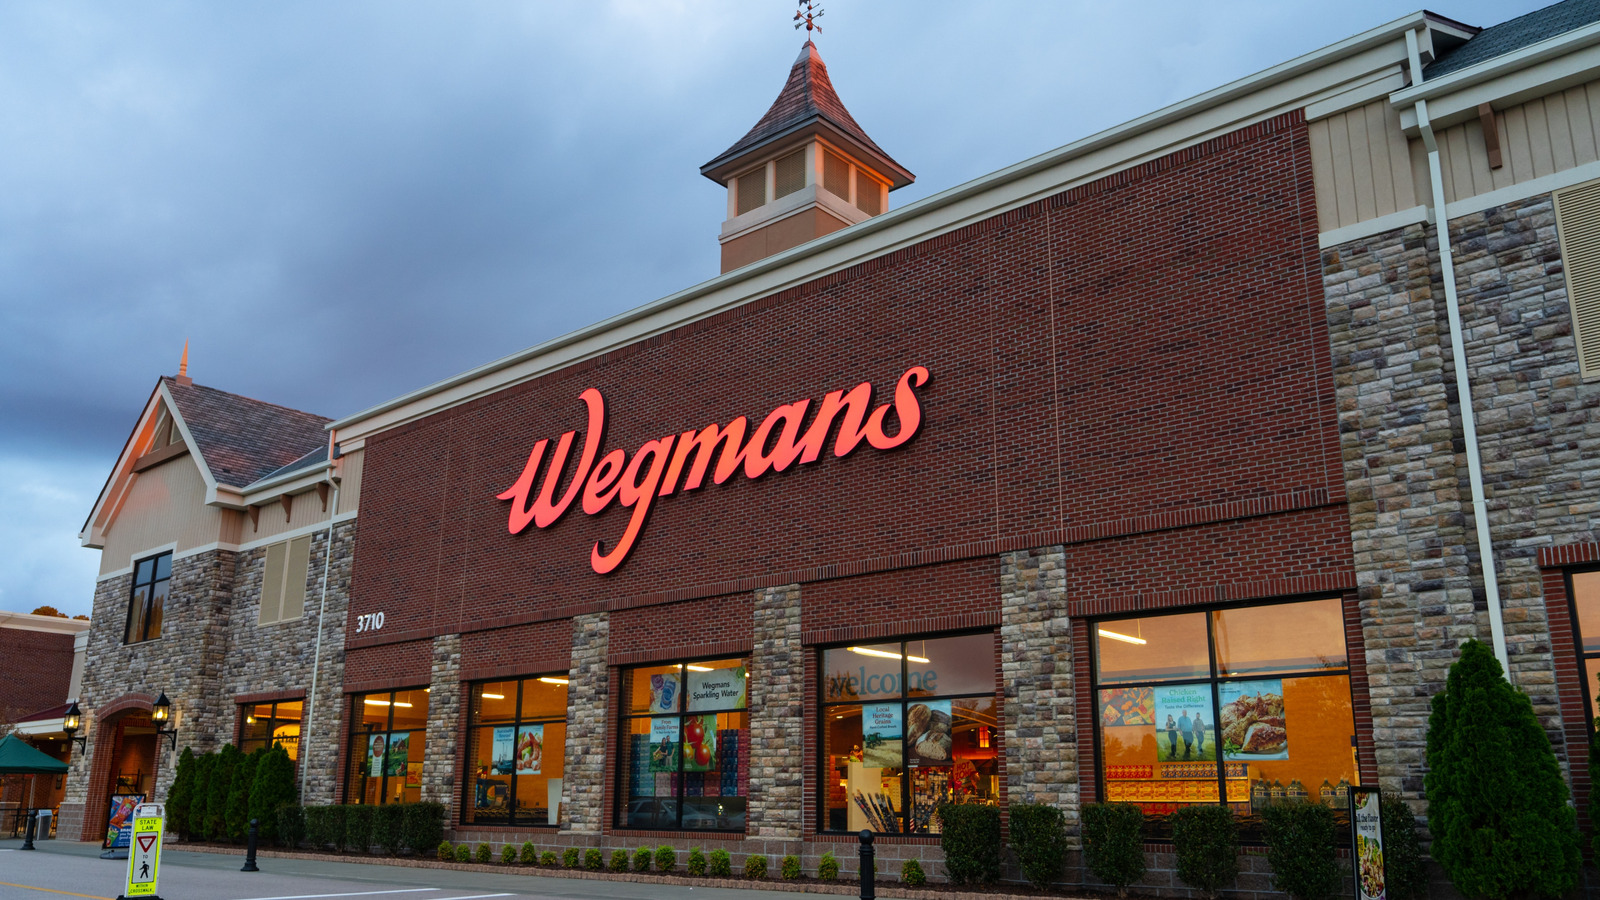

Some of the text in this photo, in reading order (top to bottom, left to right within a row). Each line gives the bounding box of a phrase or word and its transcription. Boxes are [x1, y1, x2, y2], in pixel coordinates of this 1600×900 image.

[496, 366, 931, 574] Wegmans
[356, 612, 385, 633] 3710
[702, 682, 731, 691] Wegmans
[829, 666, 938, 697] welcome
[693, 689, 739, 700] Sparkling Water
[1187, 695, 1206, 704] Right
[956, 762, 970, 771] HOT
